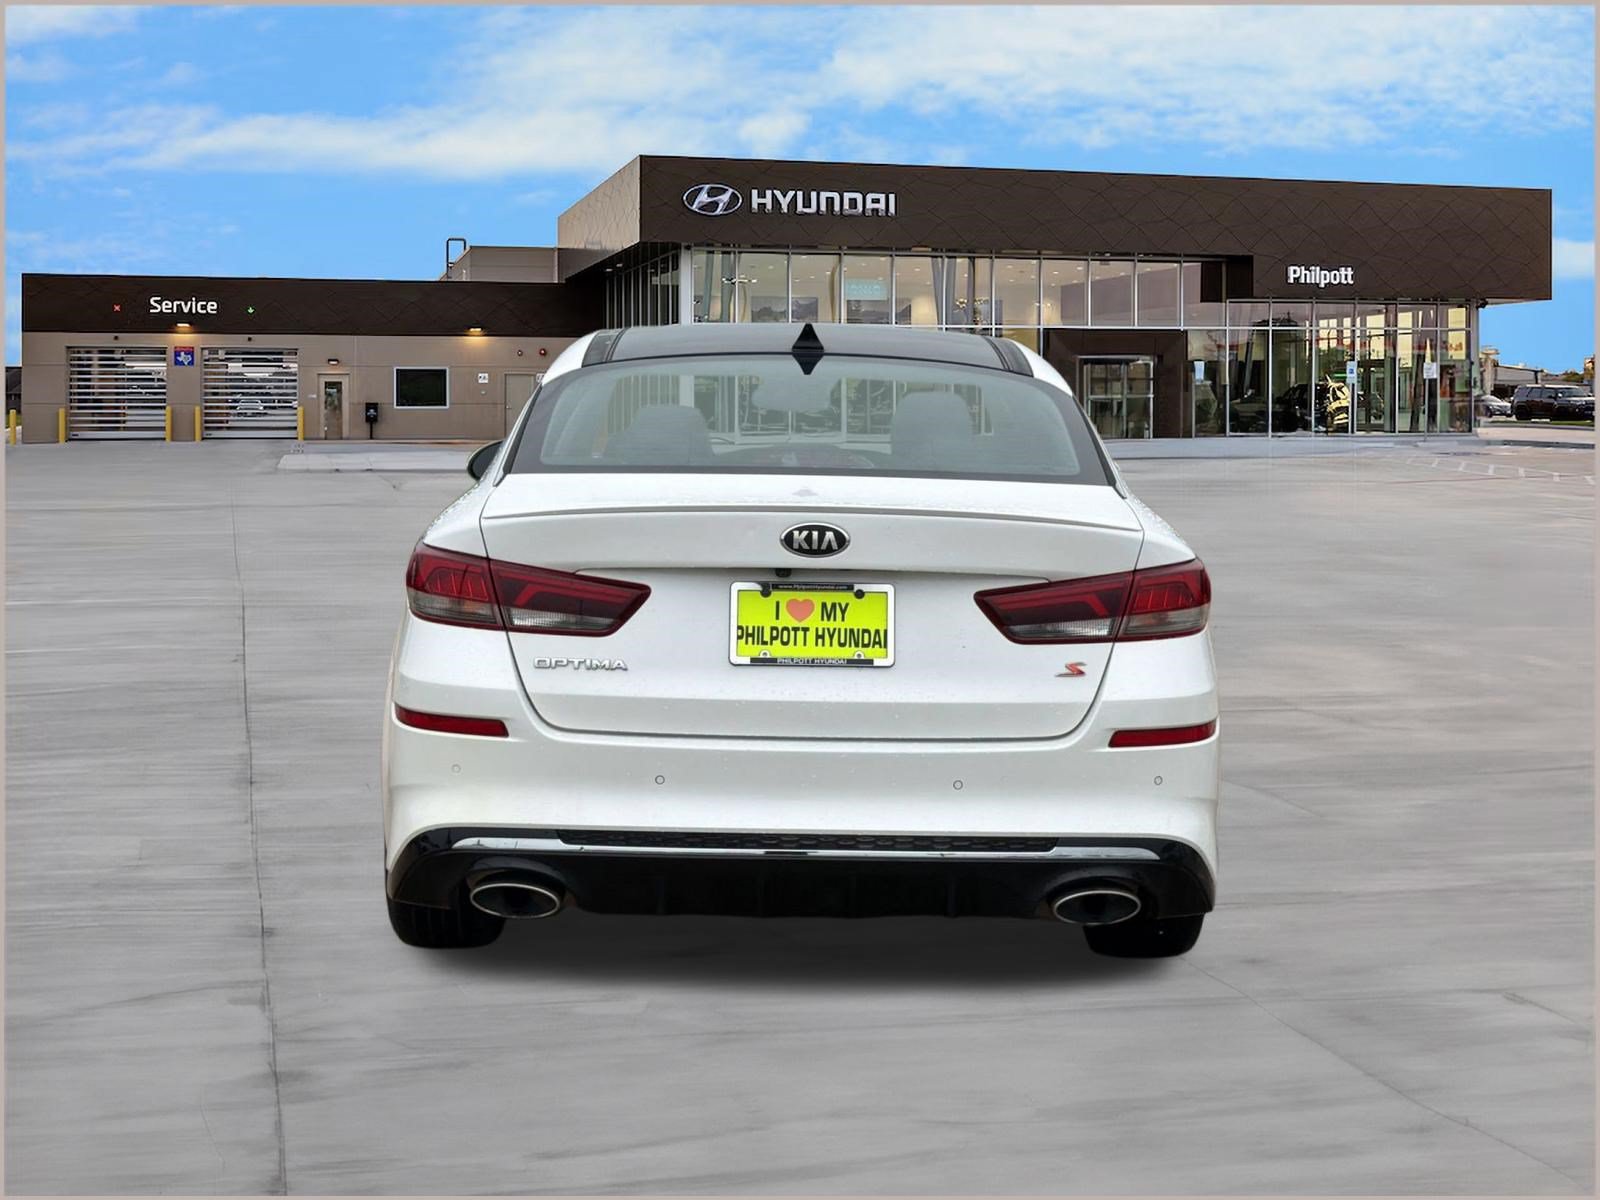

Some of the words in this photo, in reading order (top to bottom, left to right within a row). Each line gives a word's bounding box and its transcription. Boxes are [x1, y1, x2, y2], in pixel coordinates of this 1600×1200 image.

[751, 189, 896, 217] HYUNDAI
[1287, 265, 1355, 288] Philpott
[149, 296, 218, 314] Service
[792, 530, 839, 550] KIA
[775, 601, 780, 620] I
[820, 602, 849, 622] MY
[737, 625, 810, 647] PHILPOTT
[534, 657, 628, 671] OPTIMA
[777, 657, 813, 666] PHILPOTT
[814, 658, 848, 666] HYUNDAI
